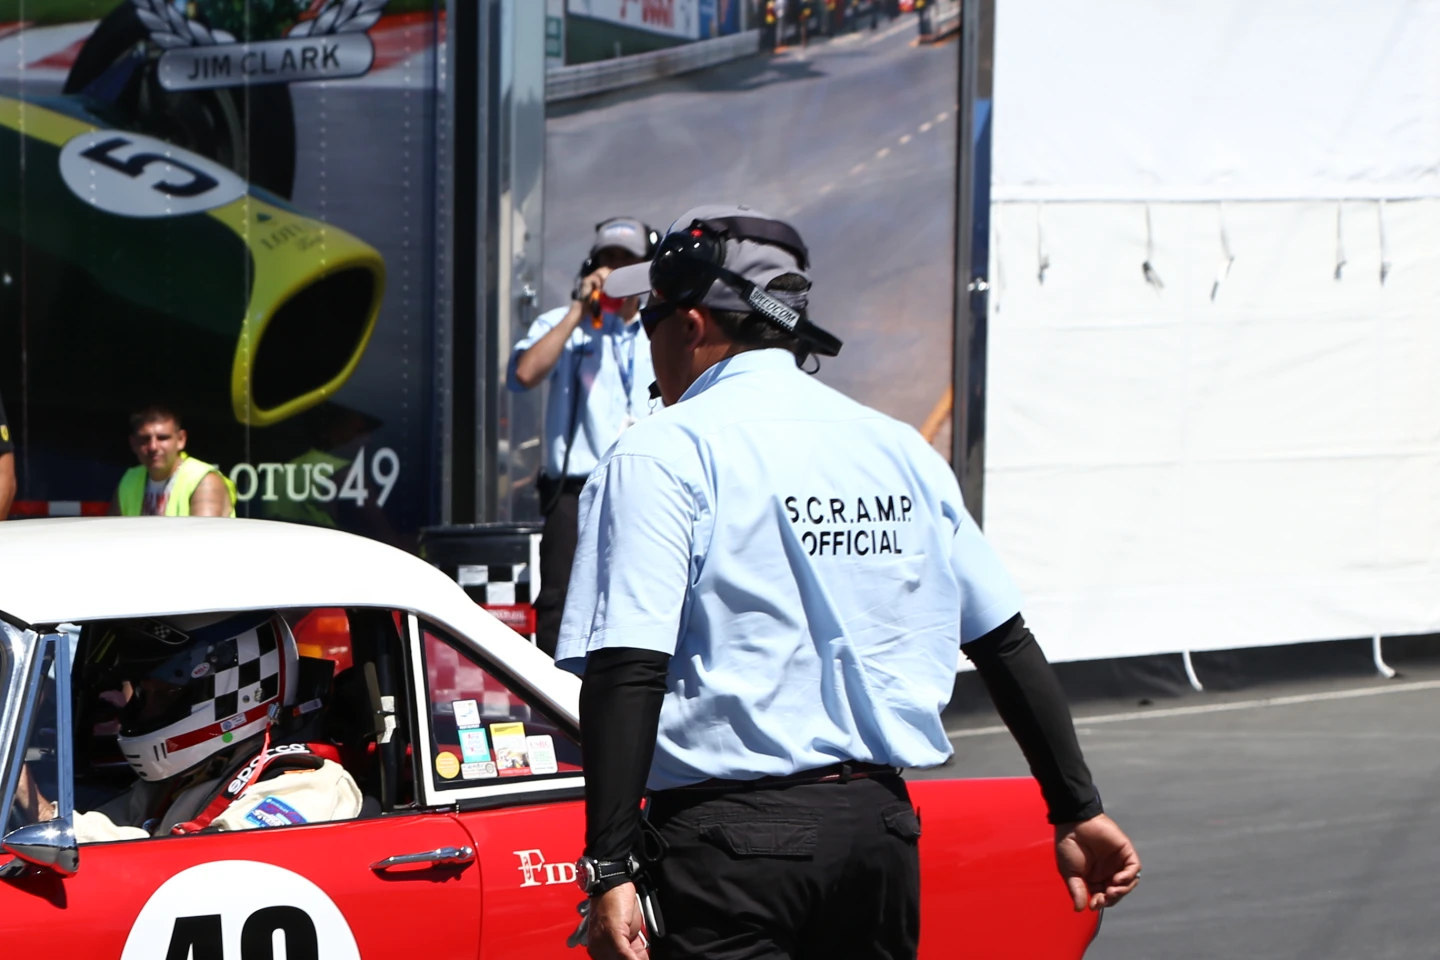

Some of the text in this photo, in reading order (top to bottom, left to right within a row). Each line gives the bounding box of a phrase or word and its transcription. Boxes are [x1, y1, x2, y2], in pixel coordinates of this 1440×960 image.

[187, 44, 341, 81] JIM CLARK
[79, 137, 220, 198] 5
[229, 462, 338, 502] OTUS
[801, 529, 903, 557] OFFICIAL
